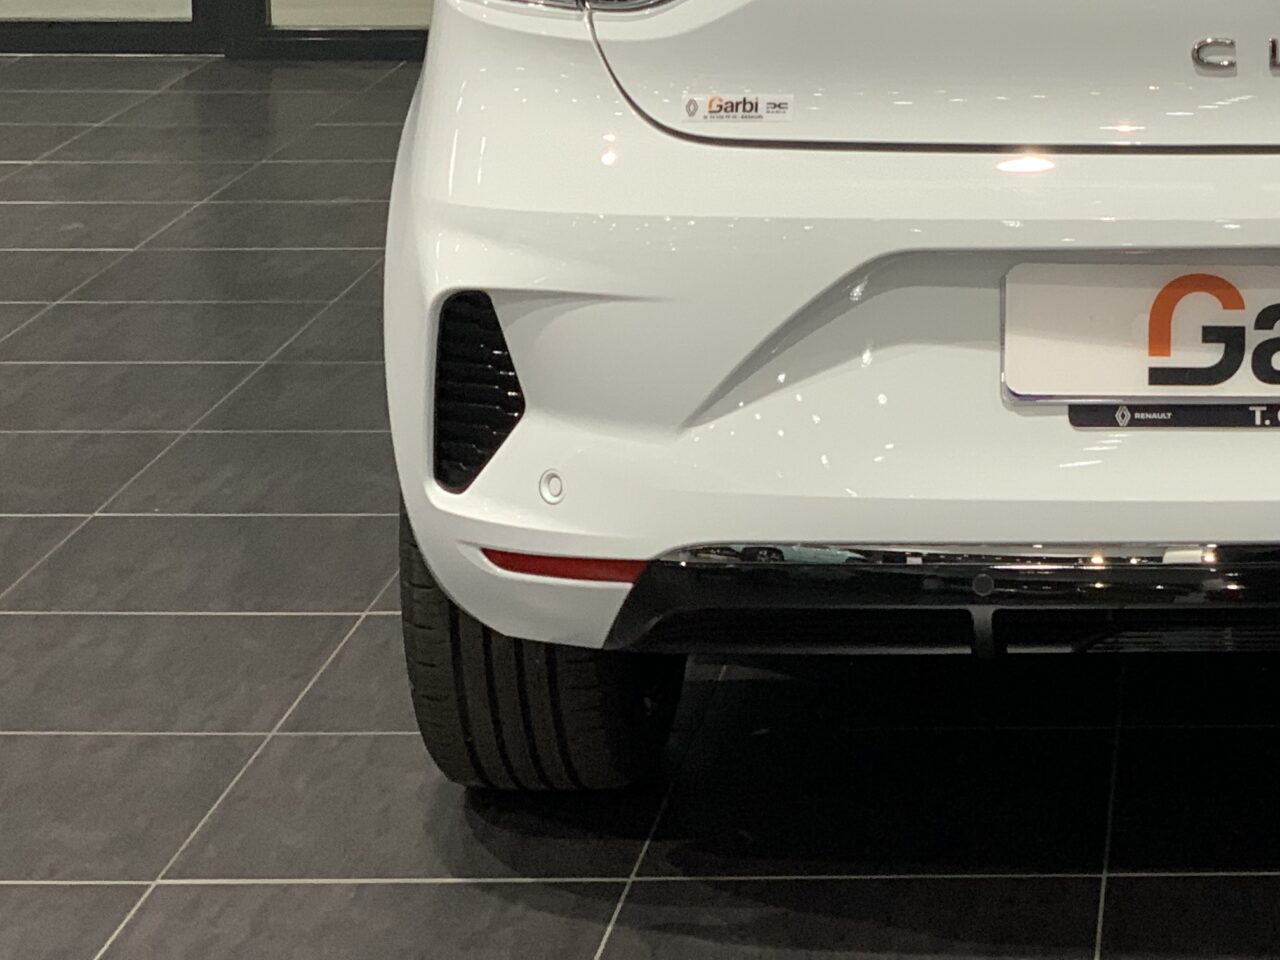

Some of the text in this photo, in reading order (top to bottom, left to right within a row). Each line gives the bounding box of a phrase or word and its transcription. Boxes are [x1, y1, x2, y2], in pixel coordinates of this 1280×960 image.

[708, 95, 760, 114] Garbi
[1134, 411, 1173, 420] RENAULT
[1248, 405, 1271, 425] T.
